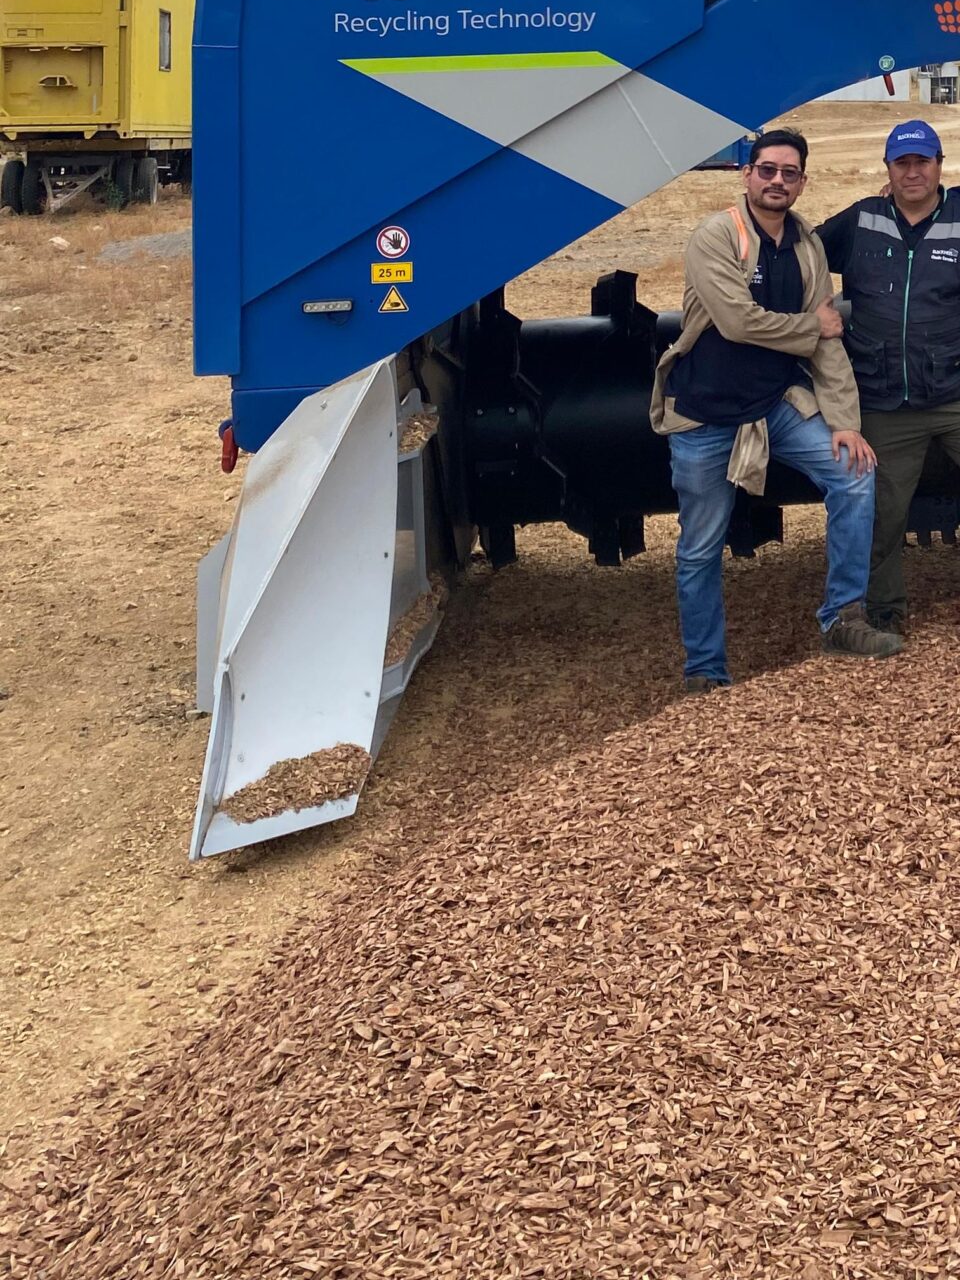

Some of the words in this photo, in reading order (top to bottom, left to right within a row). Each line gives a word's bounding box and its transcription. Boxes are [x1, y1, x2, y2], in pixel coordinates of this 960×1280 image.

[334, 10, 450, 37] Recycling
[457, 7, 596, 33] Technology
[379, 268, 392, 278] 25
[395, 269, 406, 277] m
